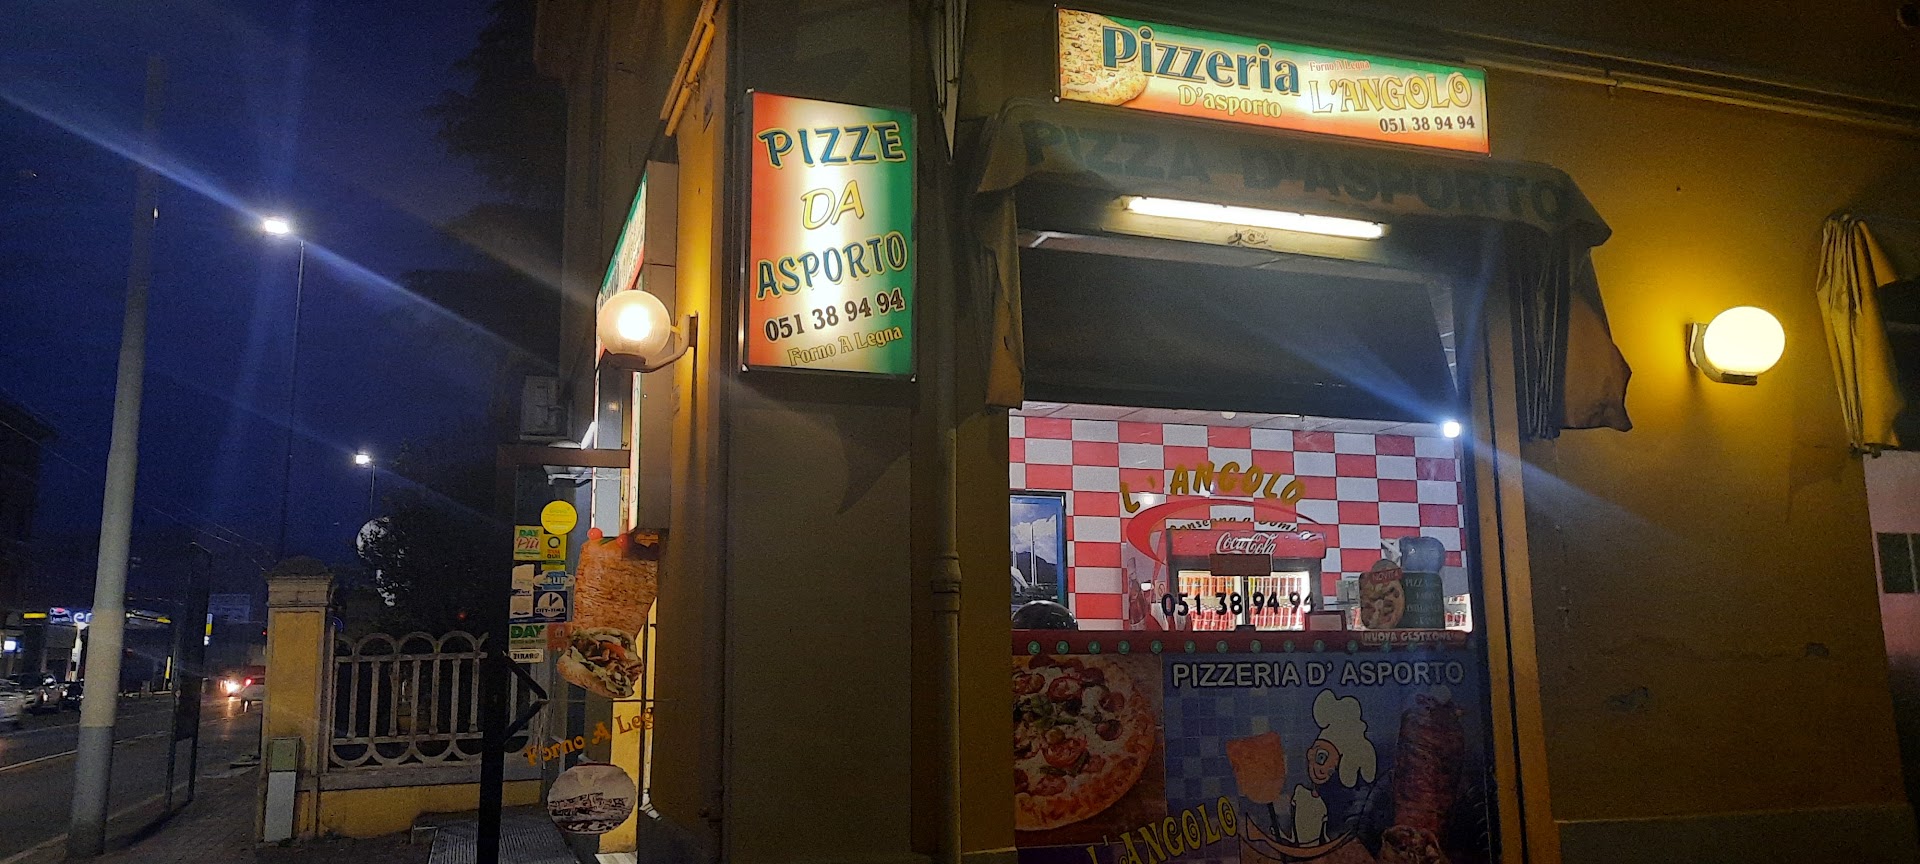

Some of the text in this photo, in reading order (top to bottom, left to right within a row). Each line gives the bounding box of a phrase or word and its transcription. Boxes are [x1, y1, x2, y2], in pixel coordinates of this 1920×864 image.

[1103, 26, 1300, 94] Pizzeria
[1309, 61, 1334, 72] Forno
[1344, 59, 1371, 71] Legna
[1178, 84, 1283, 118] D'asporto
[1308, 73, 1472, 114] L'ANGOLO
[757, 121, 908, 168] PIZZE
[1380, 115, 1475, 133] 051 38 94 94
[1019, 118, 1211, 184] PIZZA
[801, 179, 865, 231] DA
[757, 231, 909, 302] ASPORTO
[765, 288, 904, 342] 051 38 94 94
[787, 325, 904, 367] Forno A Legna
[1161, 591, 1202, 617] 051
[1215, 592, 1243, 616] 38
[1252, 591, 1280, 615] 94
[511, 625, 545, 639] DAY
[1172, 661, 1465, 687] PIZZERIA D' ASPORTO
[523, 735, 586, 766] Forno
[592, 721, 612, 745] A
